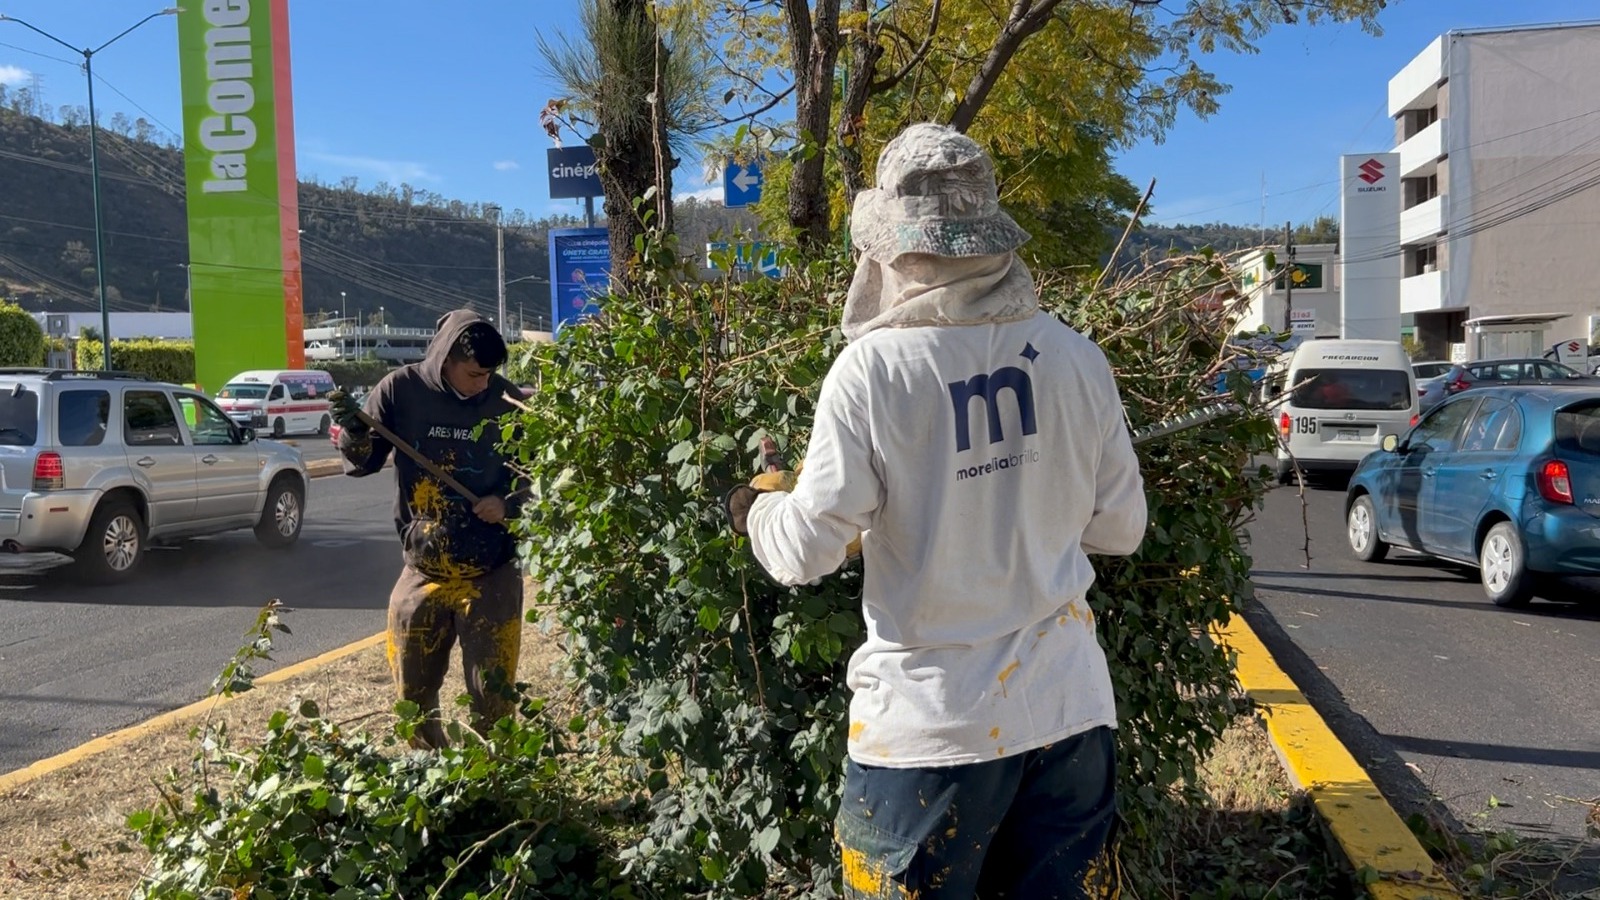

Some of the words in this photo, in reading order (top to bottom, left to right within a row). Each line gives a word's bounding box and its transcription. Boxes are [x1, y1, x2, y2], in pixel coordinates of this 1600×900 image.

[552, 162, 600, 179] cinép
[588, 248, 610, 256] GRATI
[427, 426, 451, 438] ARES
[453, 428, 475, 440] WEA
[1295, 416, 1317, 435] 195
